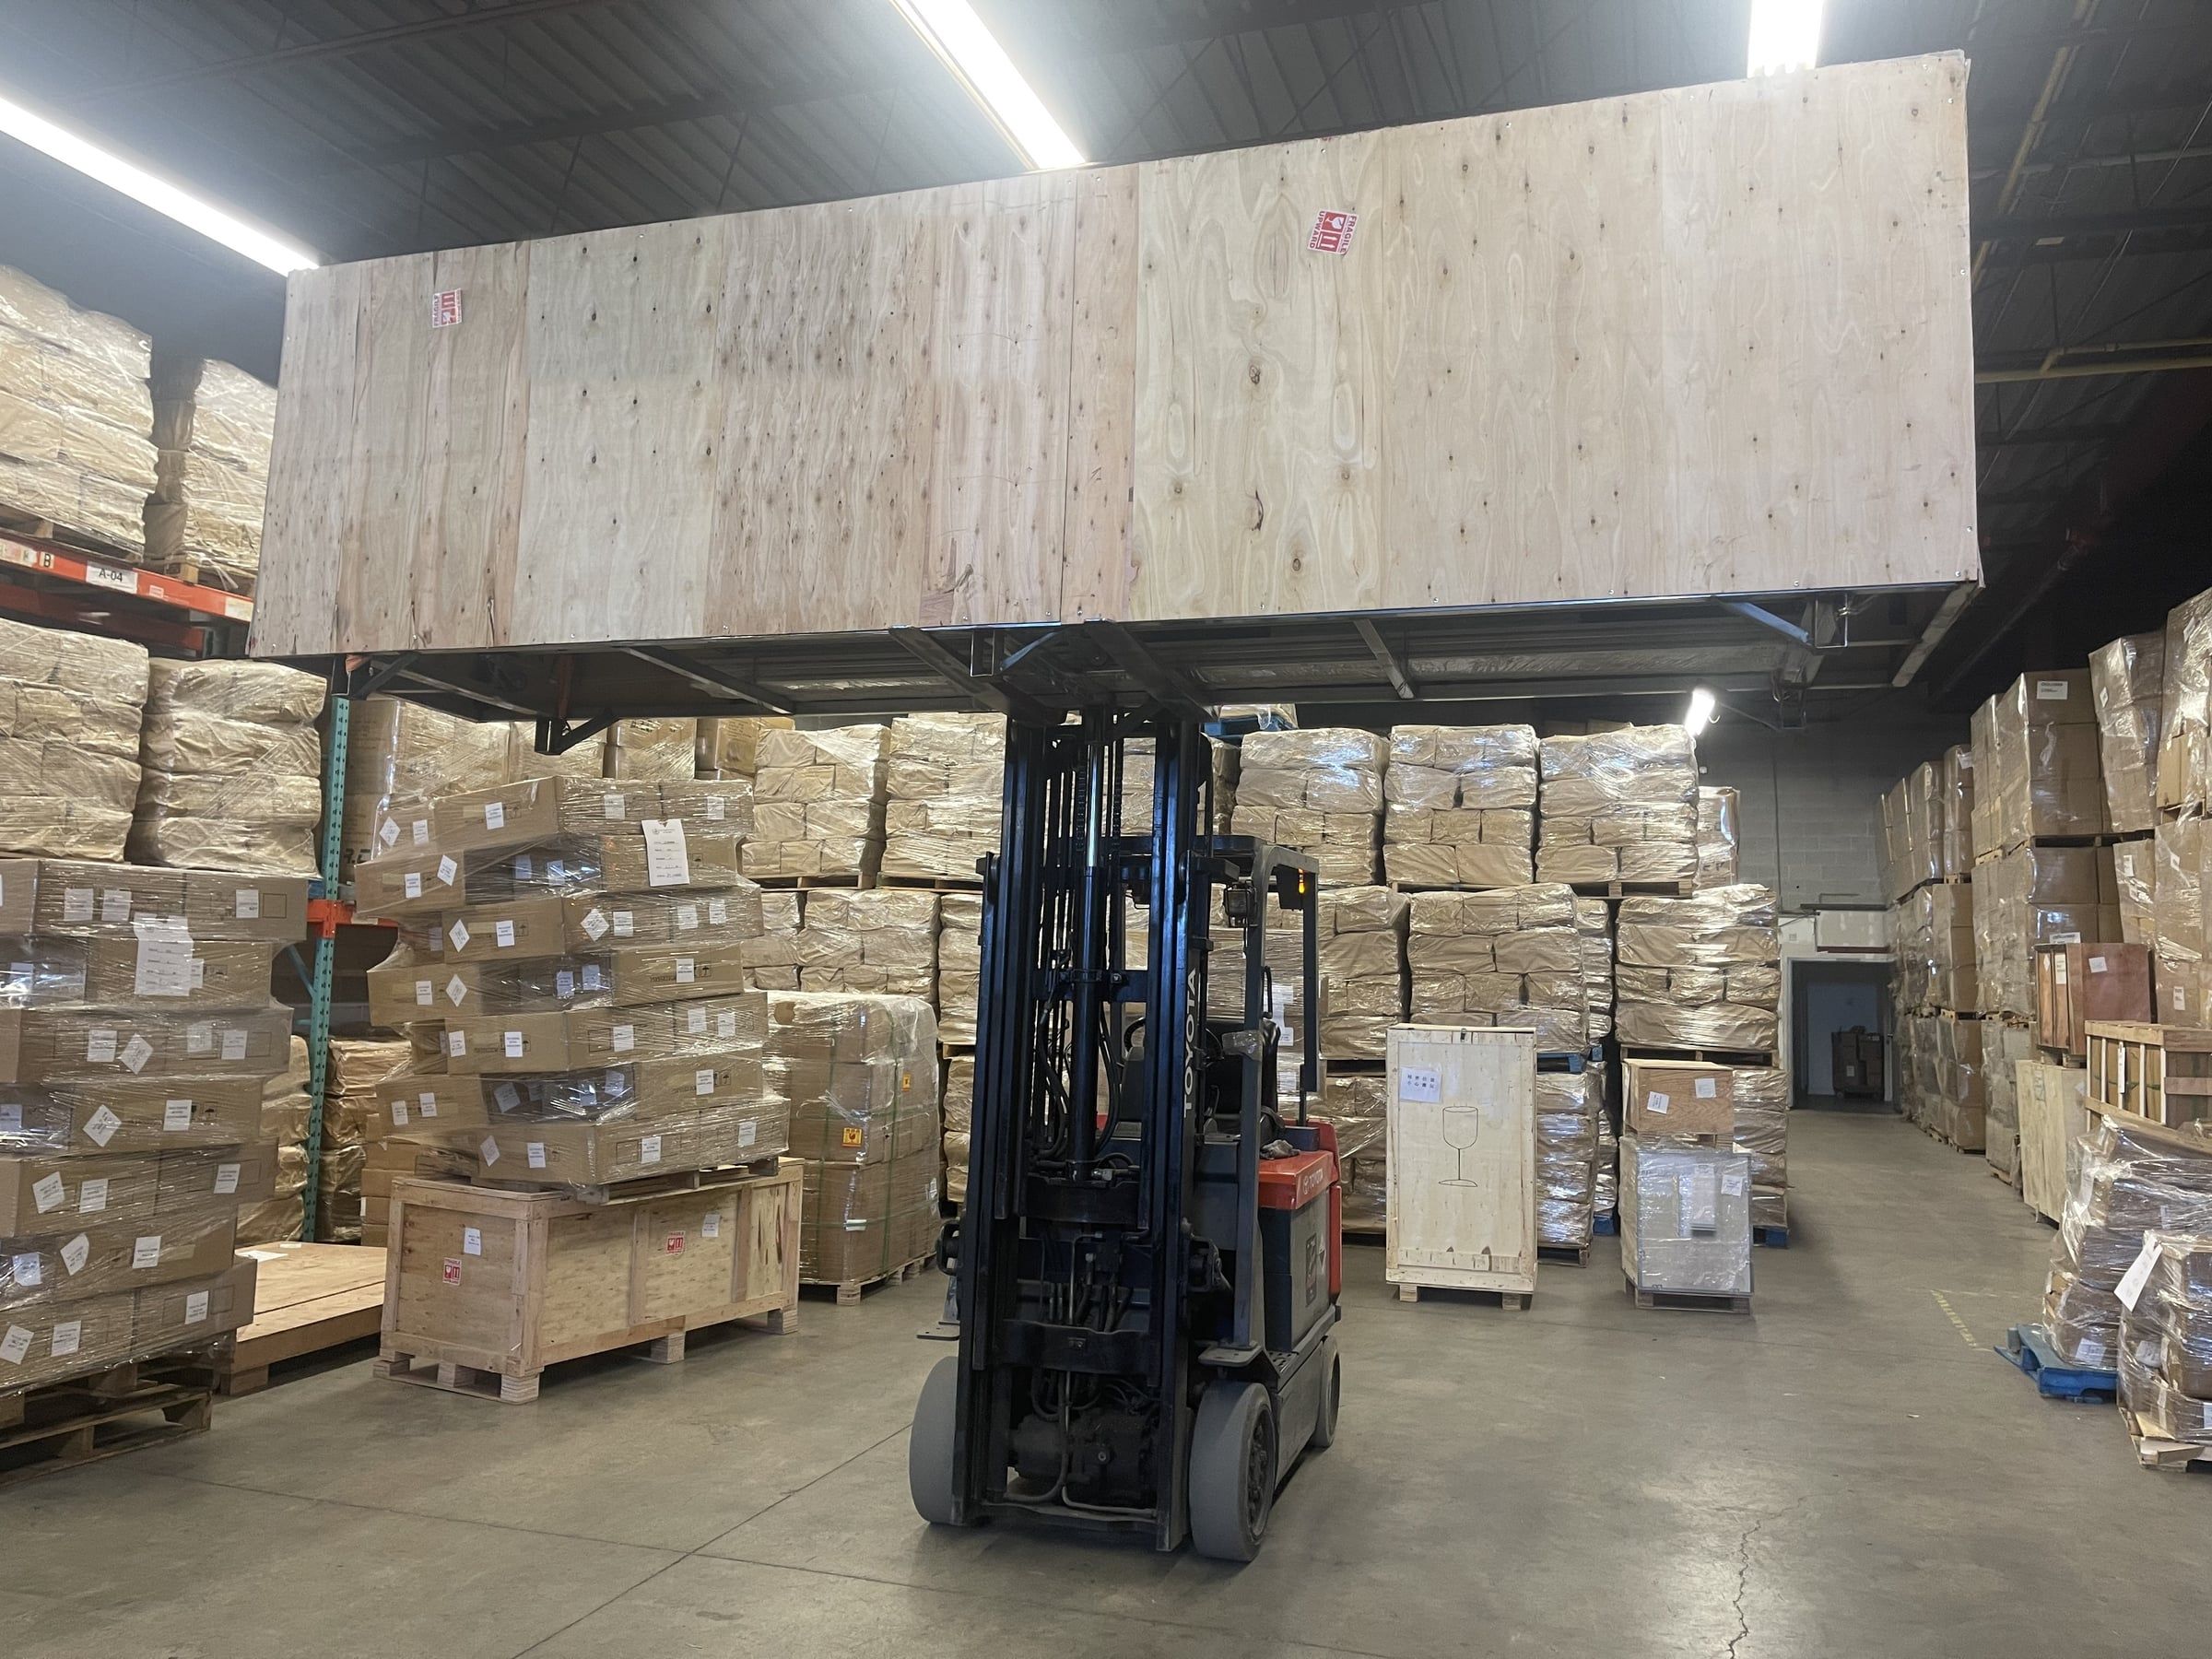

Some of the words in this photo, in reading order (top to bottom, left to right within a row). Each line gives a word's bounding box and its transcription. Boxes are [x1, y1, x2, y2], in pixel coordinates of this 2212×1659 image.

[1310, 211, 1325, 249] UPWARD
[1339, 215, 1358, 253] FRAGILE
[43, 553, 52, 568] B
[99, 569, 123, 582] A-04
[1183, 968, 1196, 1118] TOYOTA
